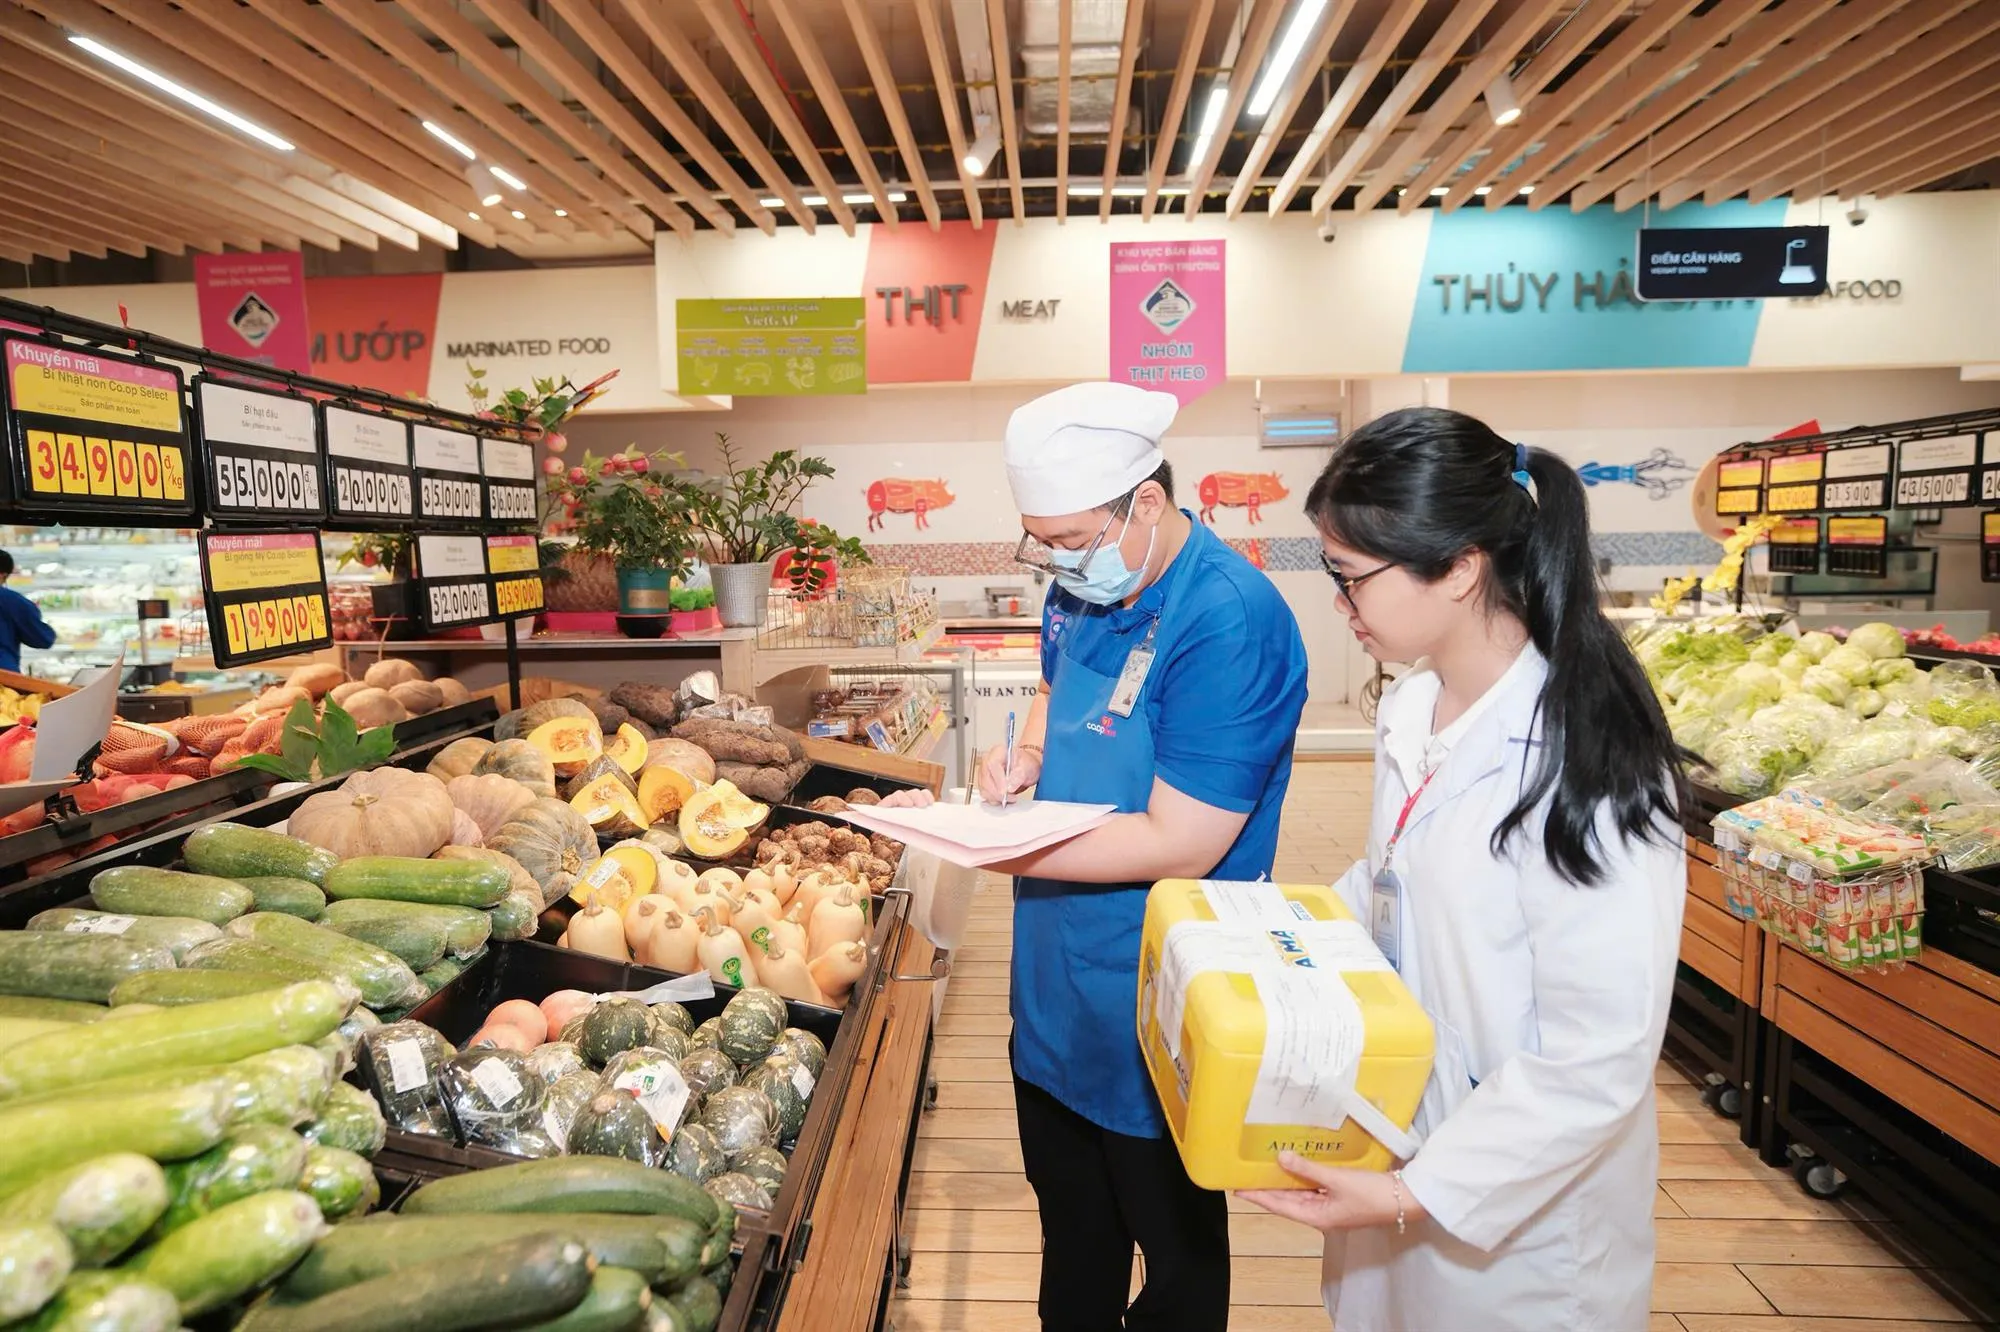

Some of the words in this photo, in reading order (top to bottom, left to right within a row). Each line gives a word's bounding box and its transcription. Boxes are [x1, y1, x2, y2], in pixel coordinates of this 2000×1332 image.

[1434, 262, 1558, 312] THỦY
[1573, 257, 1644, 310] HẢ
[876, 284, 968, 326] THỊT
[1003, 300, 1061, 317] MEAT
[12, 342, 71, 368] Khuyến
[75, 357, 100, 374] mãi
[447, 340, 552, 358] MARINATED
[558, 338, 611, 354] FOOD
[1129, 366, 1165, 384] THỊT
[1170, 366, 1207, 381] HEO
[87, 378, 106, 389] non
[109, 381, 138, 397] Co.op
[140, 386, 168, 401] Select
[37, 440, 158, 487] 34.900
[163, 454, 184, 490] đ/kg
[220, 464, 301, 501] 55.000
[340, 475, 398, 506] 20.000
[1901, 478, 1954, 498] 43.500
[424, 485, 470, 510] 35.000
[207, 536, 242, 551] Khuyến
[433, 588, 478, 617] 52.000
[230, 603, 308, 643] 19.900
[996, 687, 1015, 697] AN
